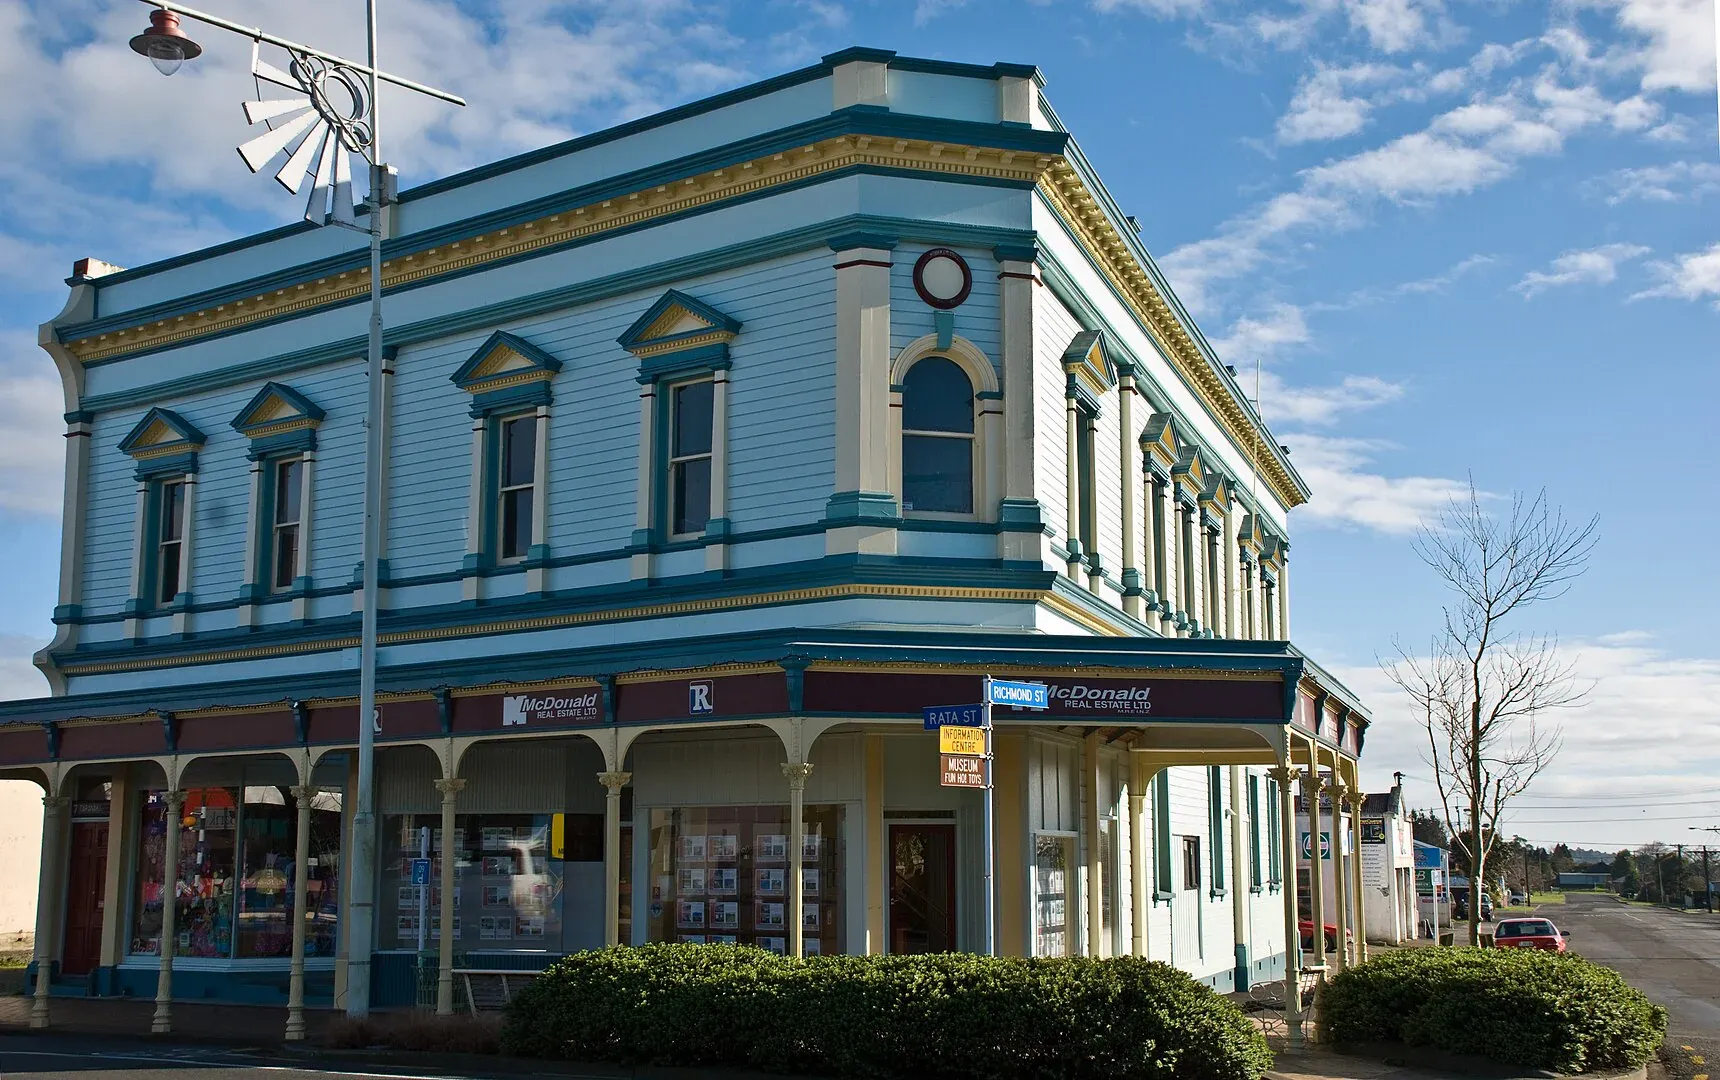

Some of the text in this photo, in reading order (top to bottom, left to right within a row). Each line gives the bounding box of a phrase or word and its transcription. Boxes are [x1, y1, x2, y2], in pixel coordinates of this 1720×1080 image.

[689, 684, 712, 711] R
[993, 686, 1044, 702] RICHMOND ST
[522, 693, 598, 711] McDonald
[1064, 700, 1151, 710] REAL ESTATE LTD
[537, 710, 555, 719] REAL
[557, 708, 582, 718] ESTATE
[584, 707, 597, 716] LTD
[929, 709, 976, 725] RATA ST
[943, 728, 984, 740] INFORMATION
[951, 741, 976, 753] CENTRE
[948, 757, 978, 773] MUSEUM
[944, 772, 956, 783] FUN
[968, 773, 982, 784] TOYS
